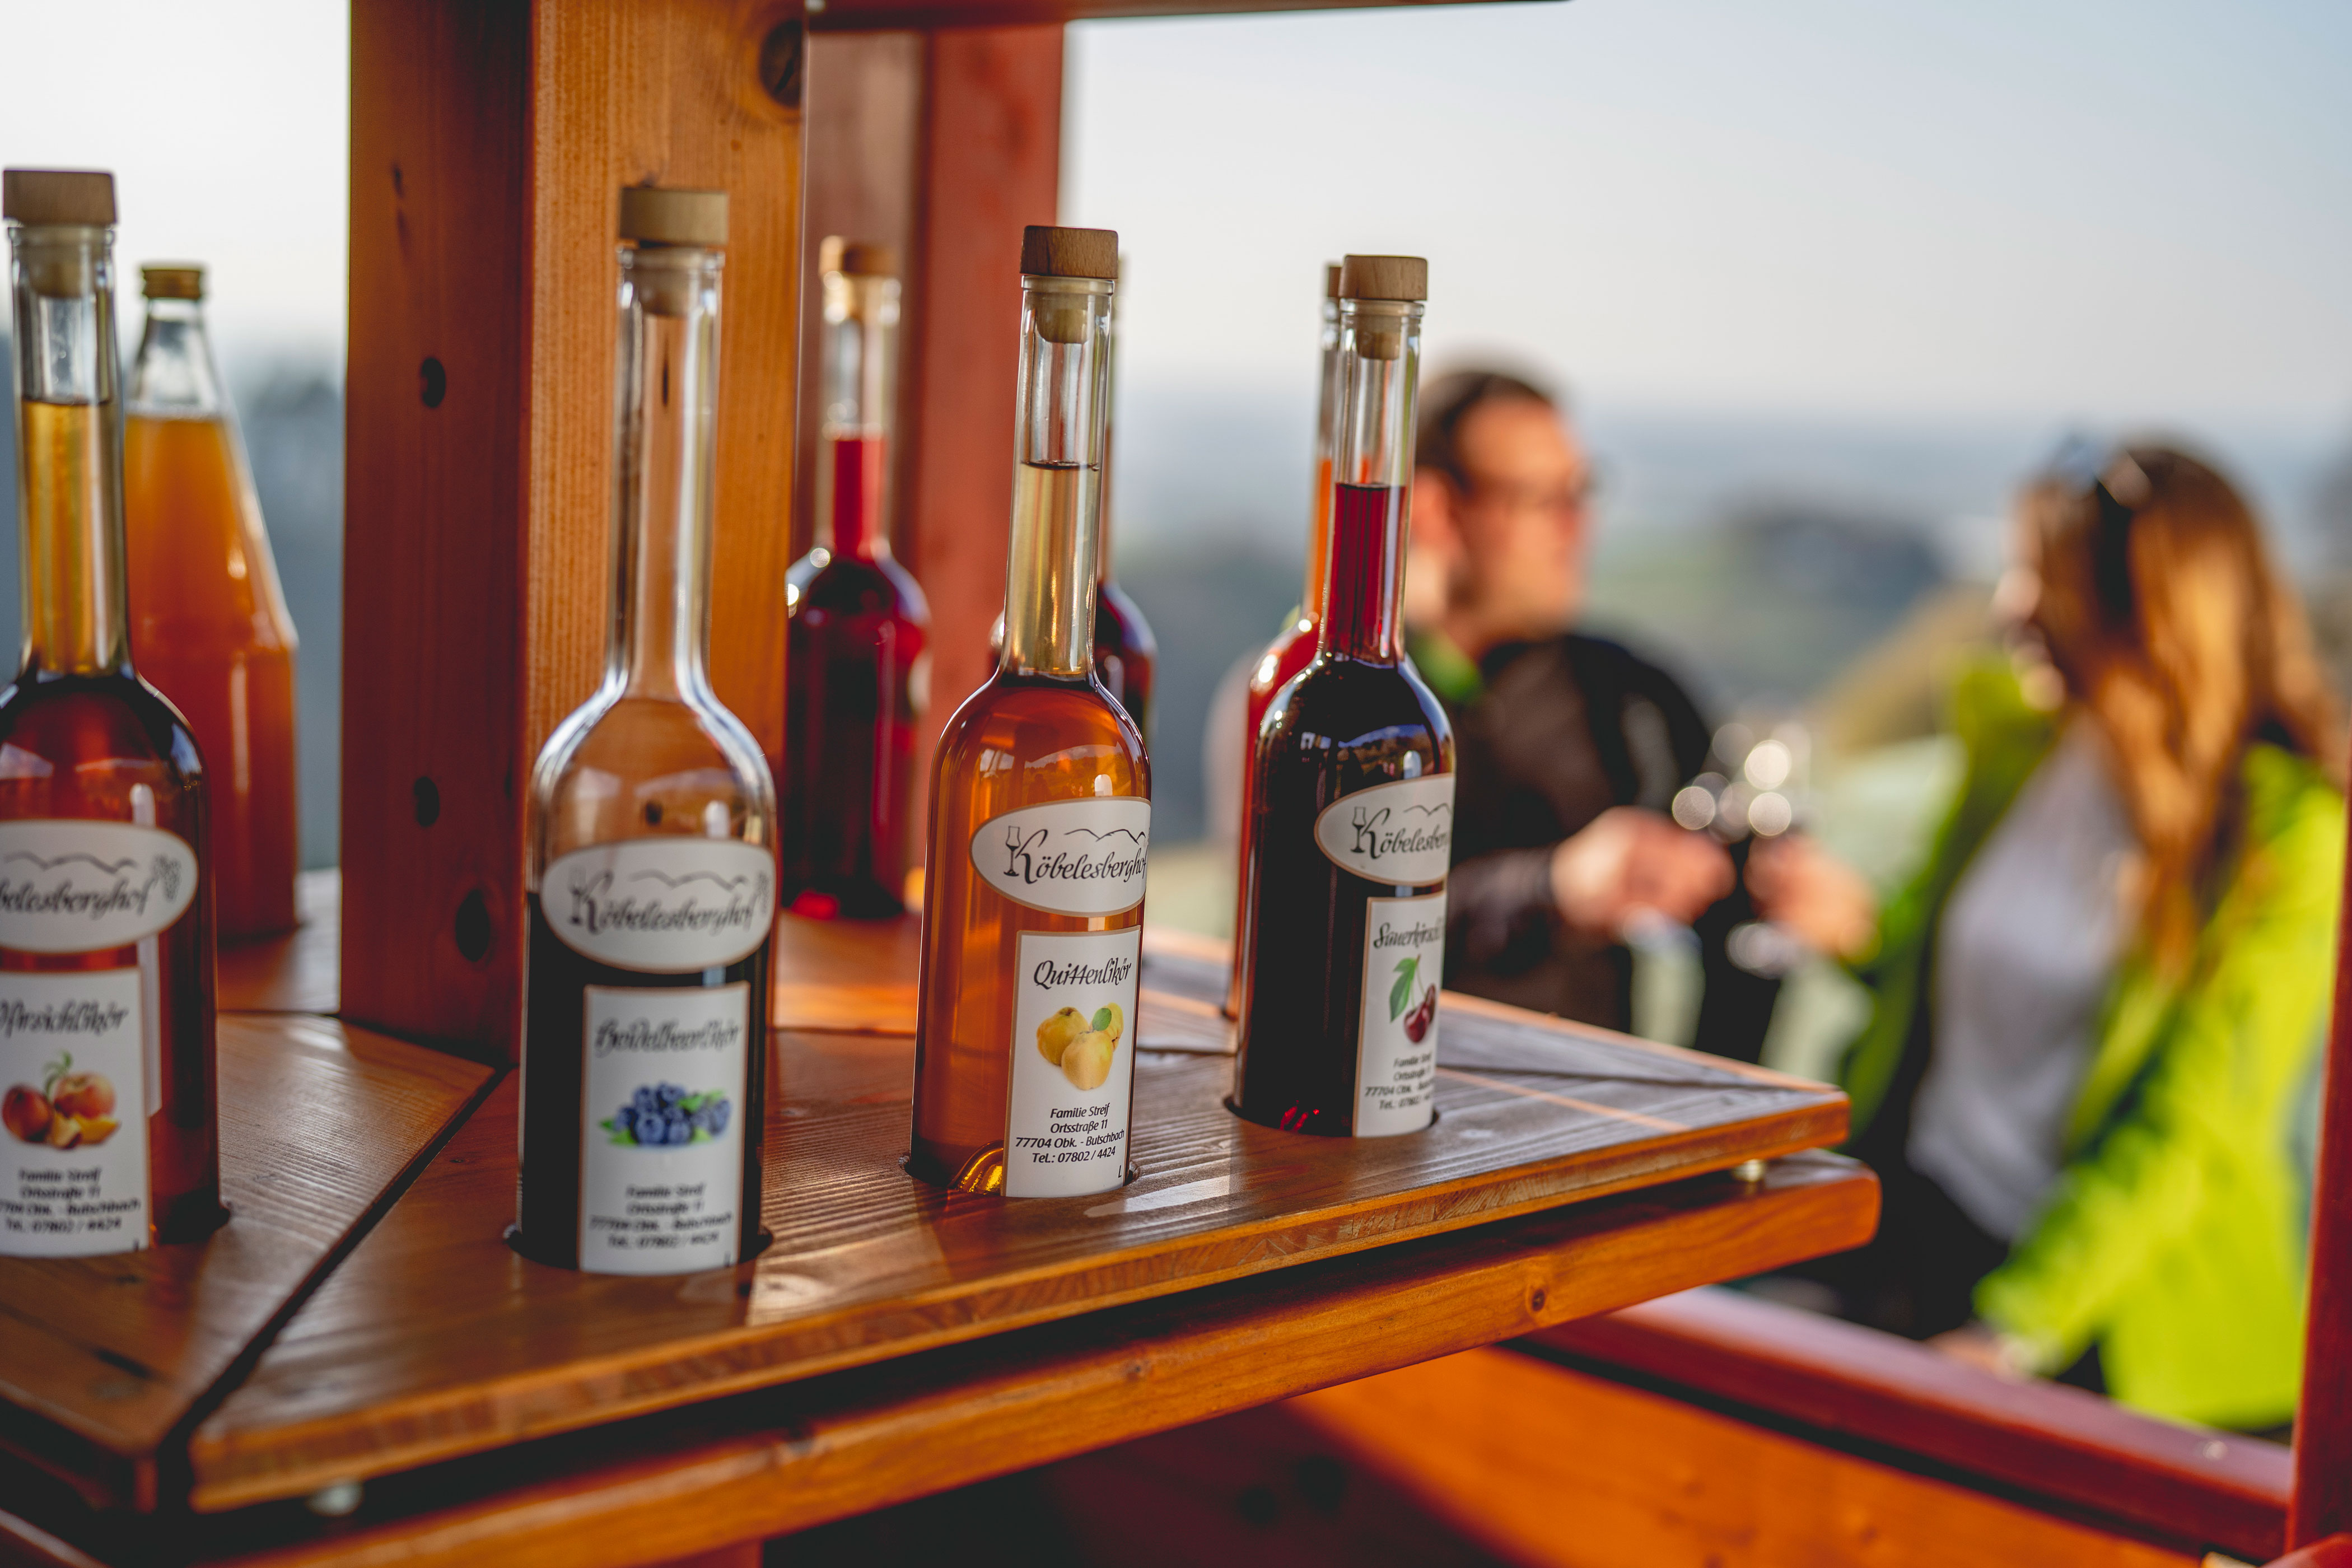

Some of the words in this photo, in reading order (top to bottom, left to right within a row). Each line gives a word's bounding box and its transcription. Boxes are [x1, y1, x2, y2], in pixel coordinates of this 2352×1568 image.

[1004, 829, 1147, 884] Köbelesberghof
[1034, 957, 1132, 990] Quittenlikör
[1050, 1107, 1087, 1118] Familie
[1088, 1102, 1110, 1117] Streif
[1050, 1121, 1099, 1134] Ortsstraße
[1101, 1119, 1108, 1129] 11
[1015, 1137, 1052, 1148] 77704
[1054, 1138, 1077, 1148] Obk.
[1085, 1129, 1124, 1146] Butschbach
[1032, 1152, 1056, 1163] Tel.:
[1057, 1151, 1090, 1163] 07802
[1097, 1146, 1116, 1159] 4424
